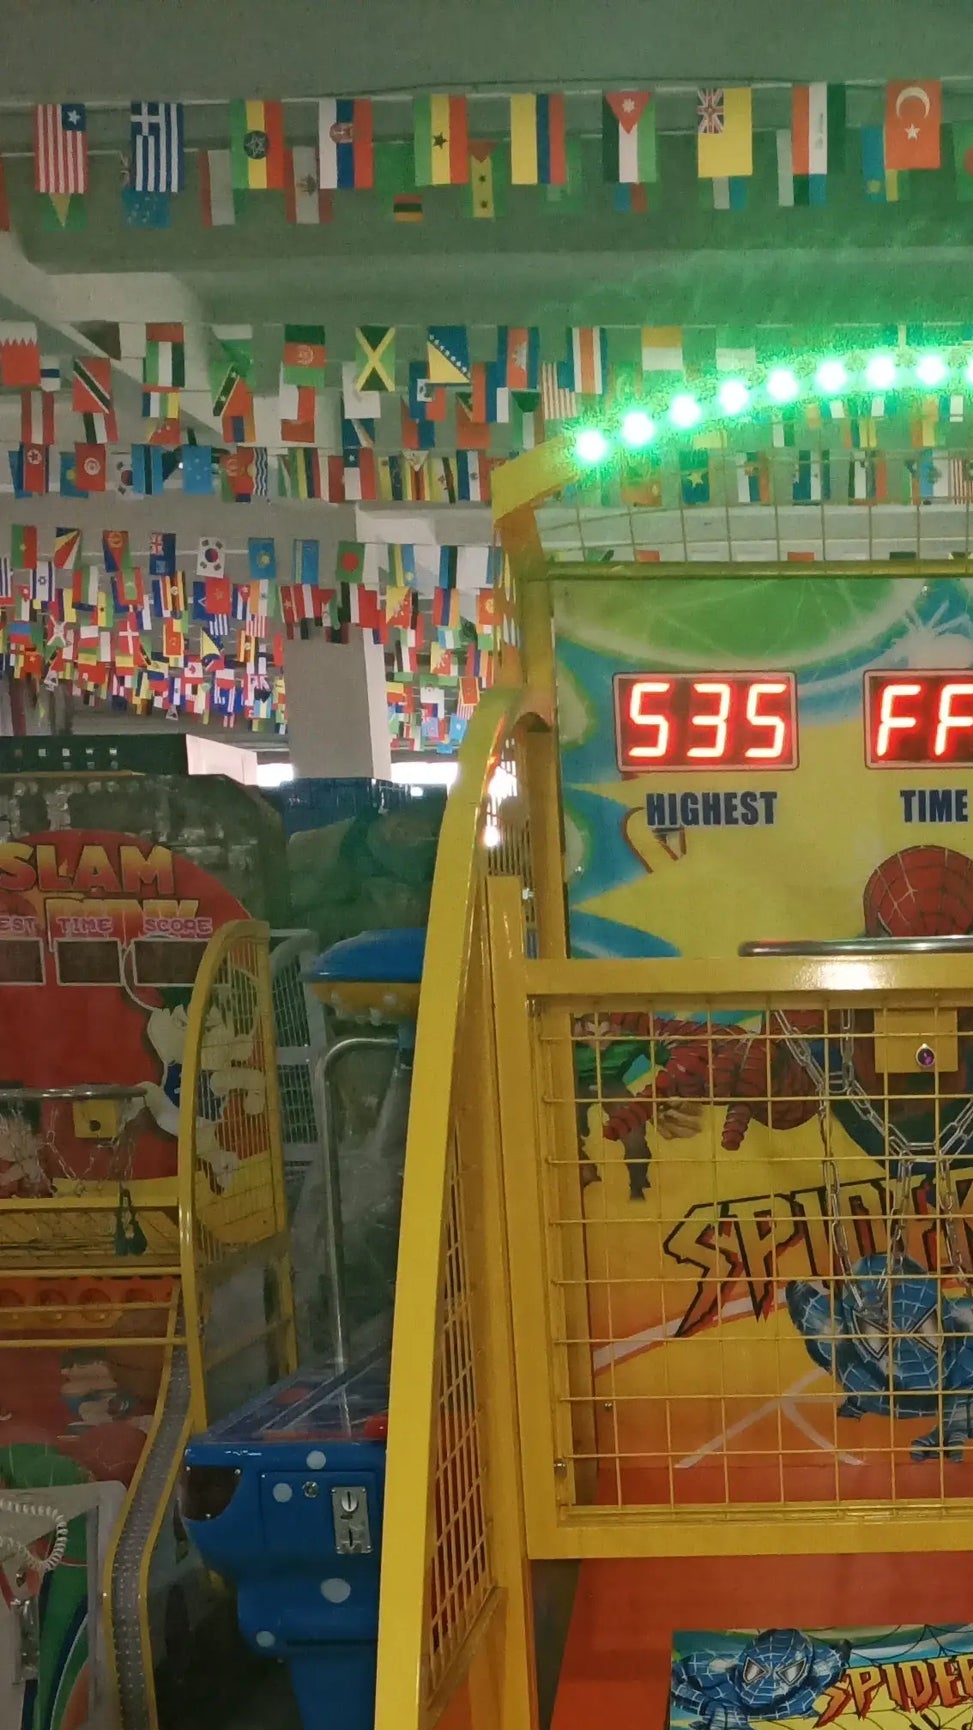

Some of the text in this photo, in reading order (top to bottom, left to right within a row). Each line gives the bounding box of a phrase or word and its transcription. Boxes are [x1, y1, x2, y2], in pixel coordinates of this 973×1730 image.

[628, 682, 787, 758] 535
[645, 791, 778, 826] HIGHEST
[900, 789, 969, 823] TIME
[0, 841, 176, 895] SLAM
[56, 916, 113, 935] TIME
[142, 916, 214, 935] SCORE
